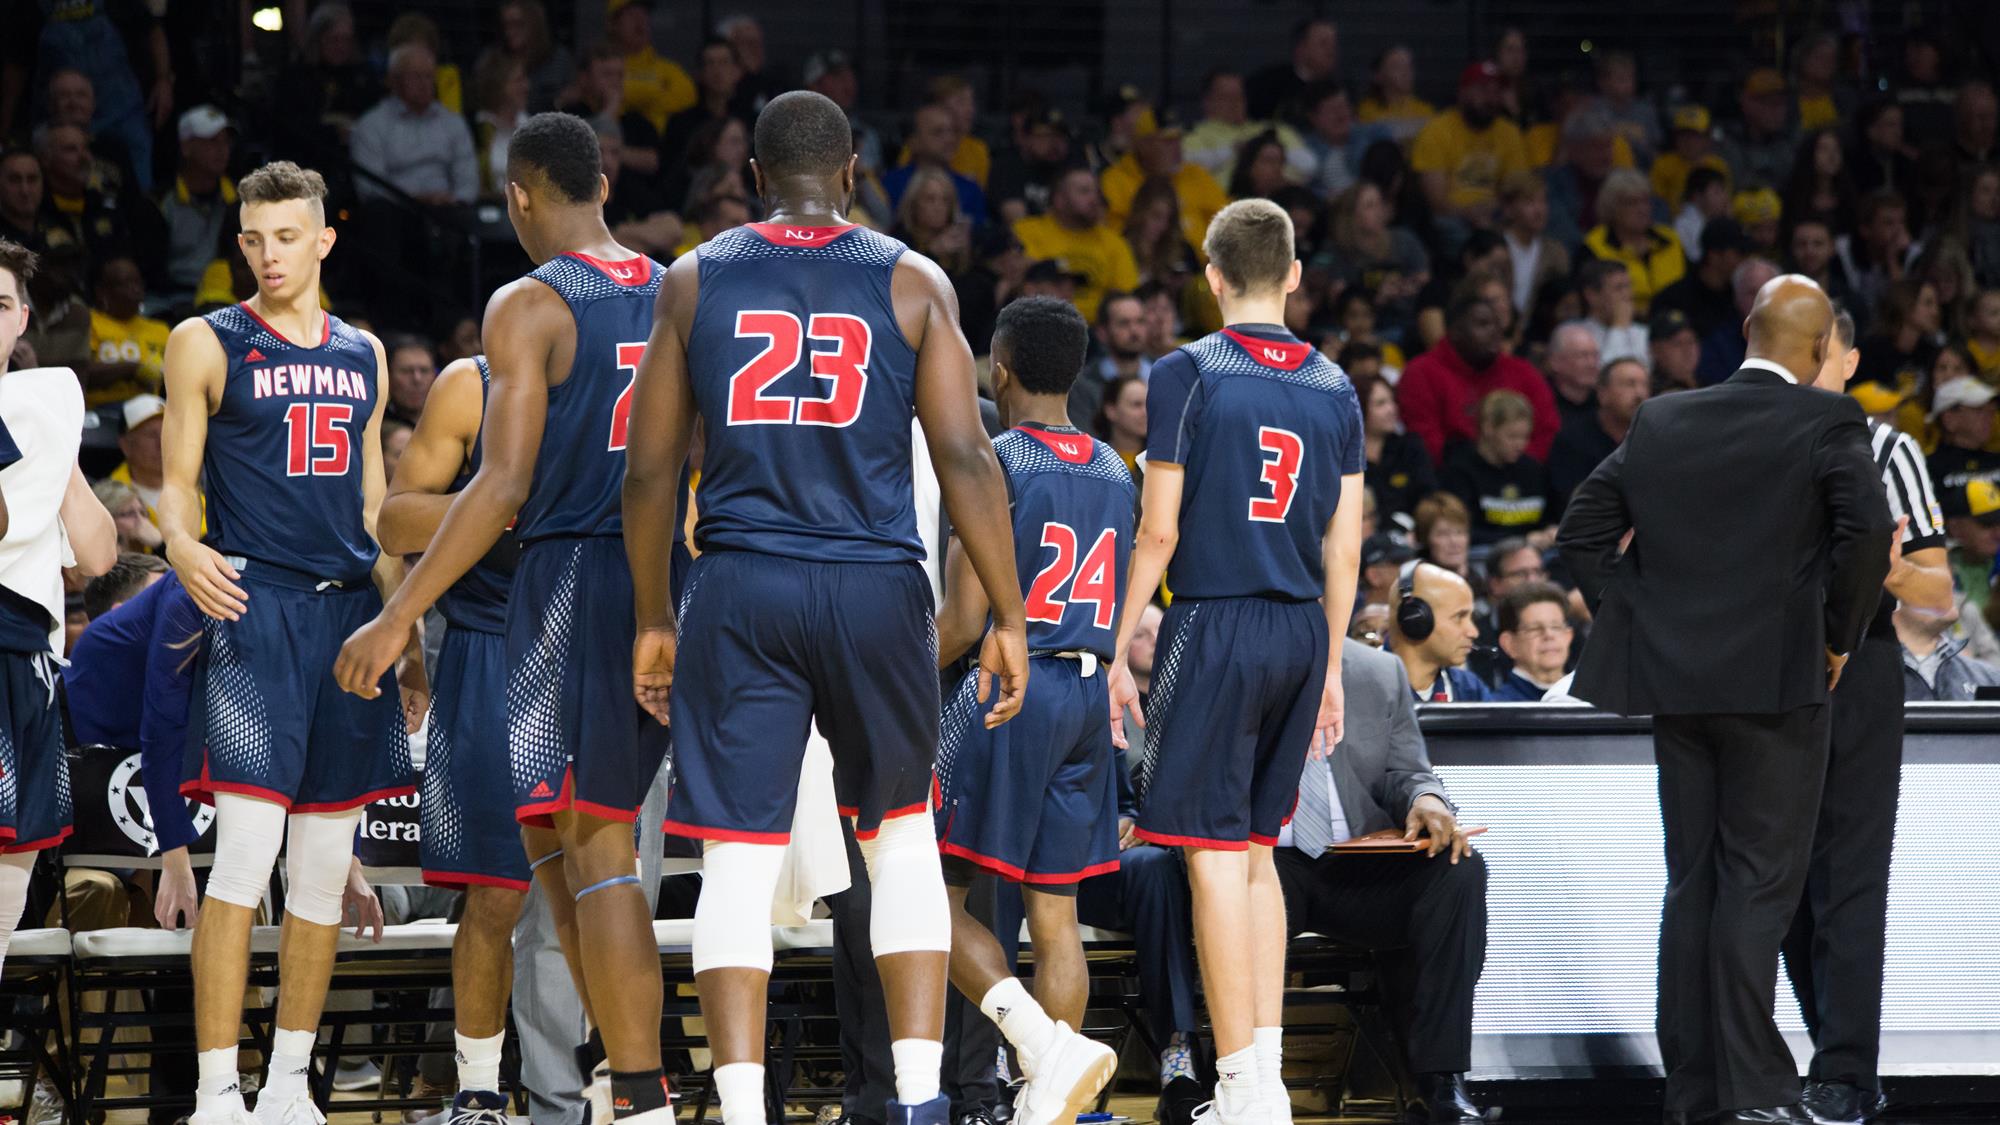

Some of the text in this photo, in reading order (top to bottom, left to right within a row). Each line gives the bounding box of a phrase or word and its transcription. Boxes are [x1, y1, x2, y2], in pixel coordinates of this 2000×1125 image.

[253, 364, 367, 401] NEWMAN
[727, 310, 872, 428] 23
[283, 402, 353, 477] 15
[1248, 425, 1305, 523] 3
[1024, 521, 1118, 630] 24
